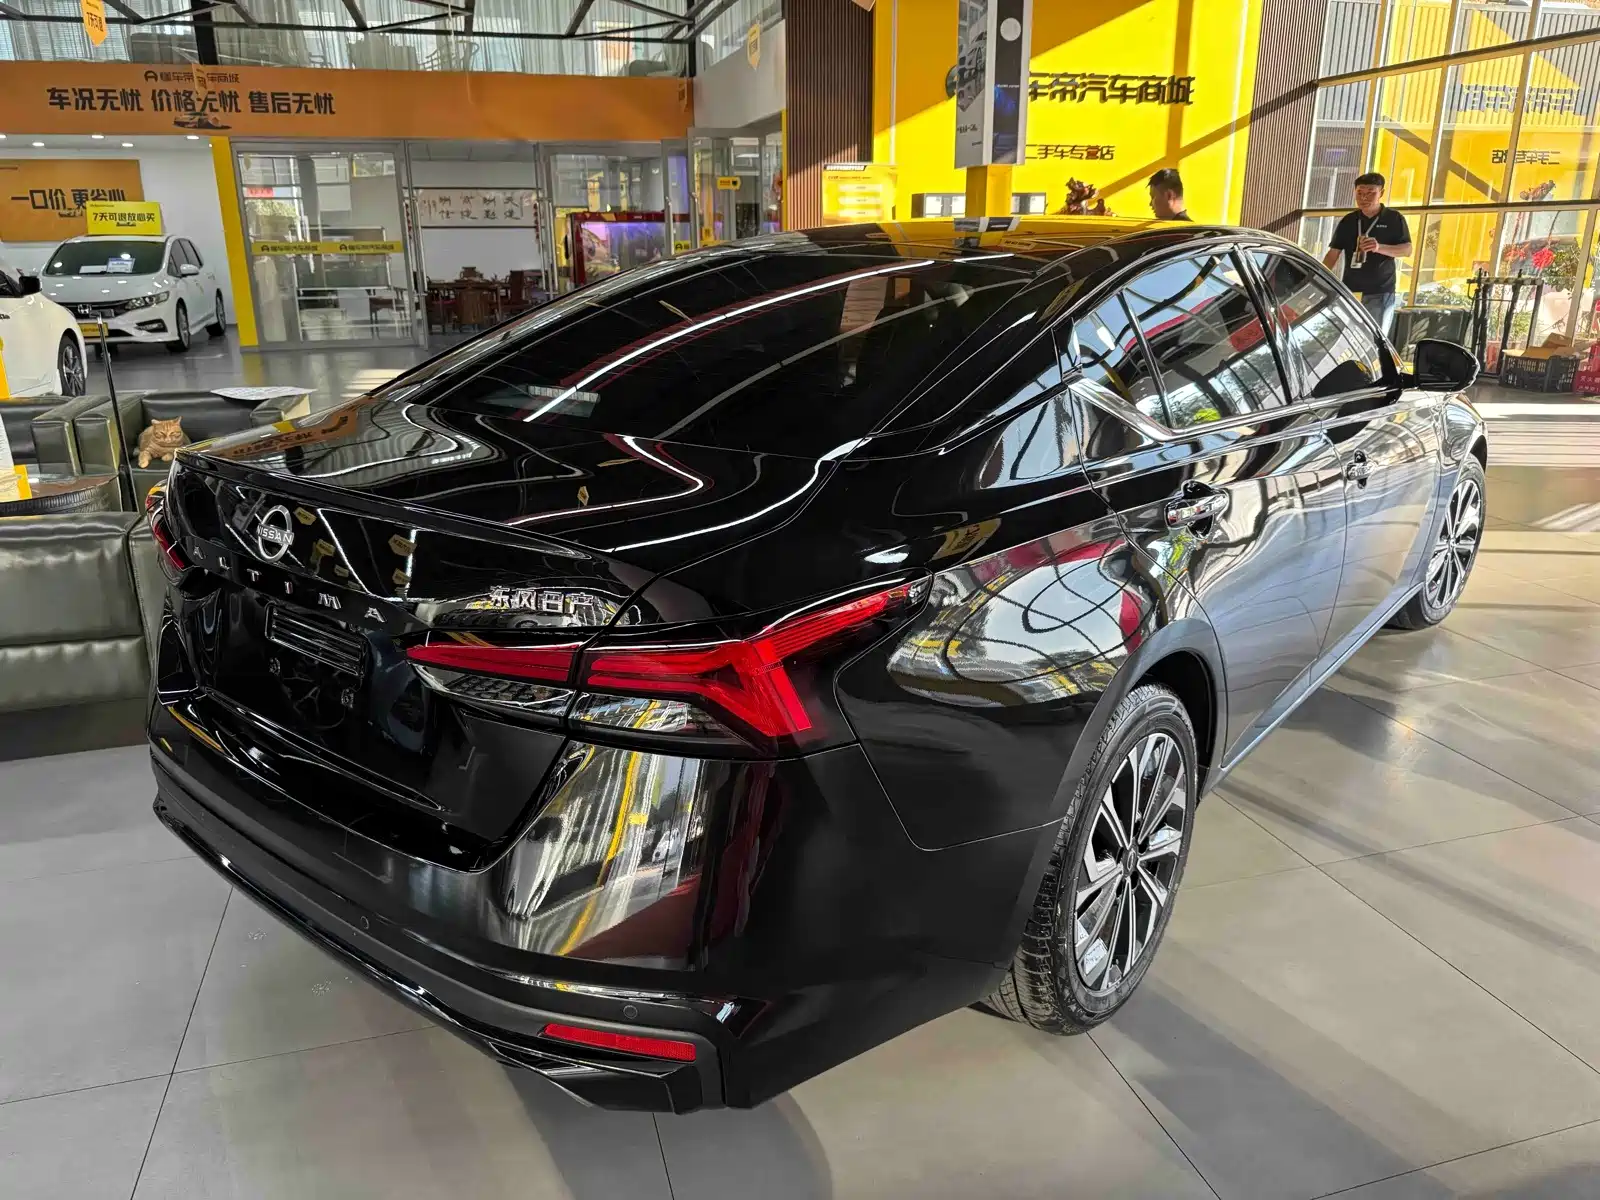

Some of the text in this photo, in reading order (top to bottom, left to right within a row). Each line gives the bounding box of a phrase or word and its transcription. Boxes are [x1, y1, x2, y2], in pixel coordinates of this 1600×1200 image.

[160, 71, 240, 84] 懂车帝车商城
[46, 87, 144, 111] 车况无忧
[248, 90, 336, 115] 售后无忧
[1025, 144, 1115, 160] 二手车专营店
[11, 189, 66, 210] 一口价
[93, 212, 155, 222] 7天可退放心买
[256, 523, 294, 546] NISSAN
[193, 546, 387, 624] ALTIMA
[490, 585, 595, 614] 东风日产
